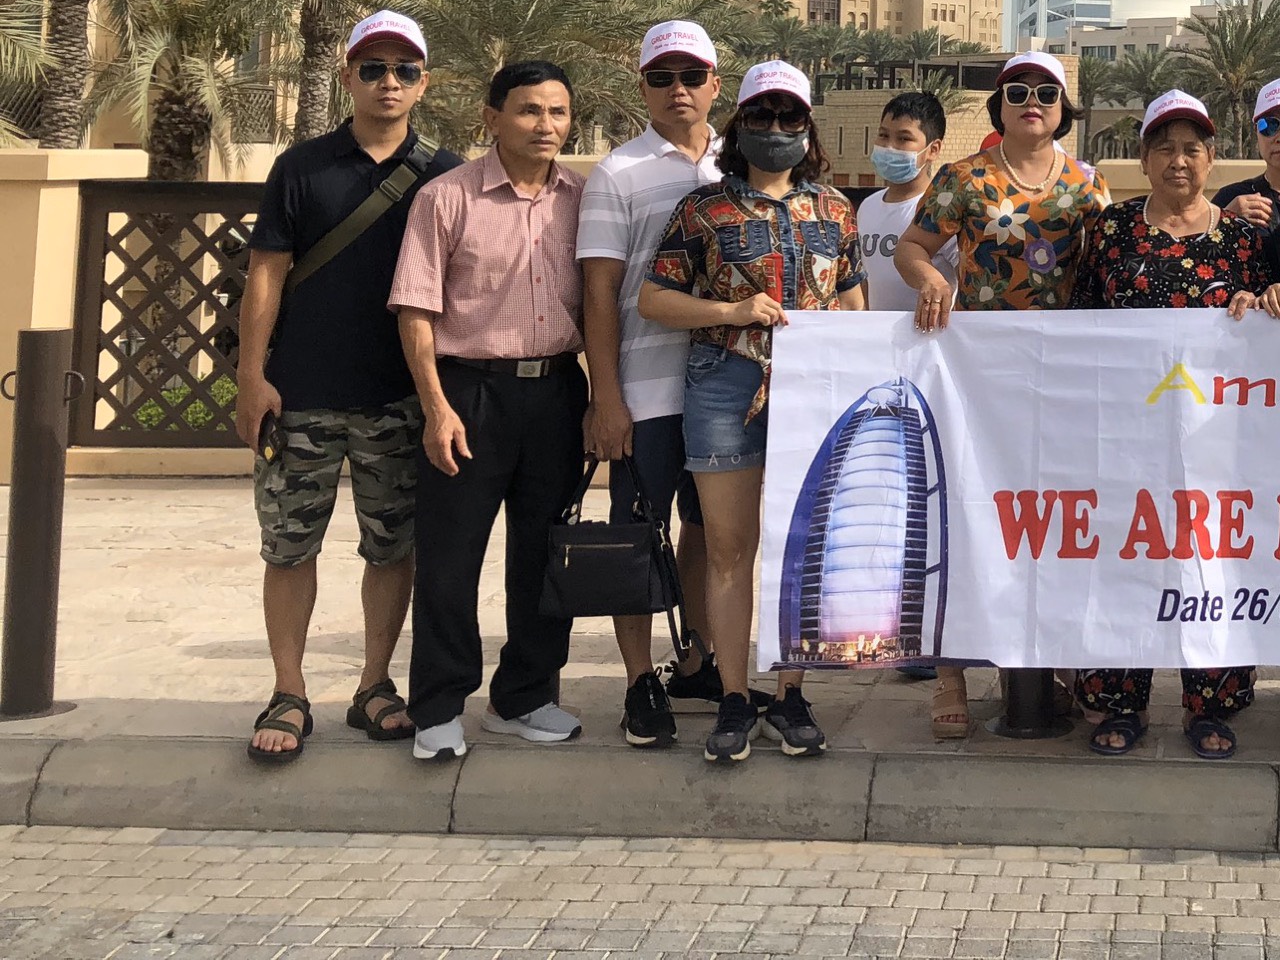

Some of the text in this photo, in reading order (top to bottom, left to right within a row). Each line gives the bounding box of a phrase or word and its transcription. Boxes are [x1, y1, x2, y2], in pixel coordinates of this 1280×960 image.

[361, 21, 384, 34] GROUP
[385, 21, 411, 31] TRAVEL
[651, 32, 699, 45] GROUP TRAVEL
[755, 71, 778, 81] GROUP
[1154, 99, 1174, 113] GROUP
[993, 489, 1100, 560] WE
[1119, 489, 1254, 560] ARE
[1156, 588, 1223, 624] Date
